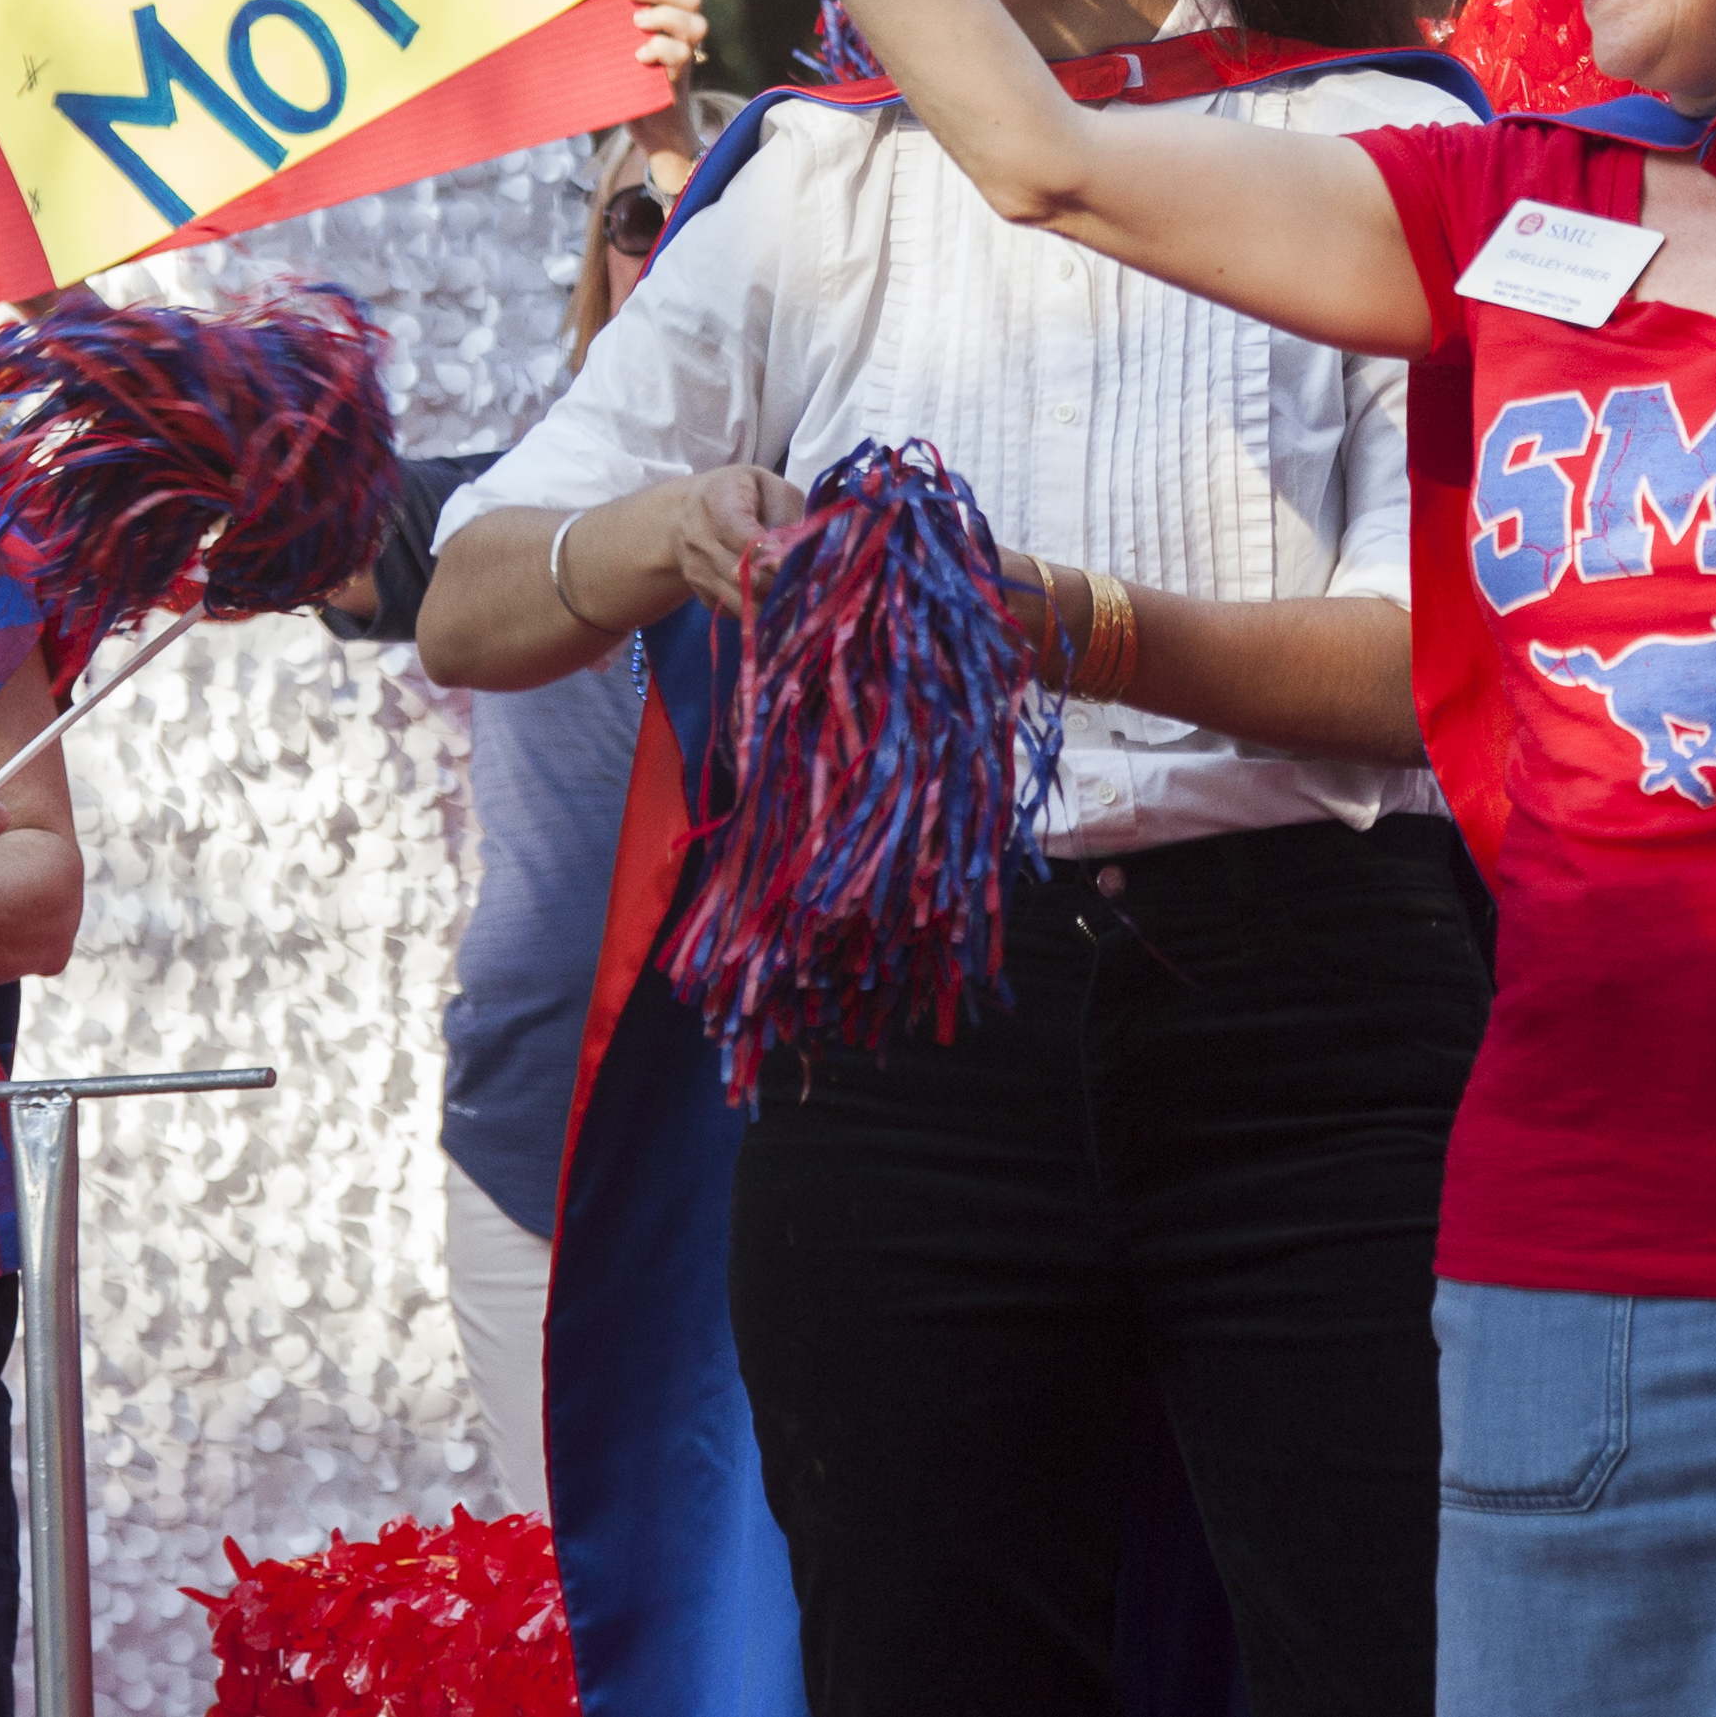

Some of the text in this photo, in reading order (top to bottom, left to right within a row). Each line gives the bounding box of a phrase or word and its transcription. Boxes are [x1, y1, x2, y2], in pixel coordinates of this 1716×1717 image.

[1545, 221, 1596, 247] SMU
[1505, 248, 1612, 283] SHELLEY HUBER
